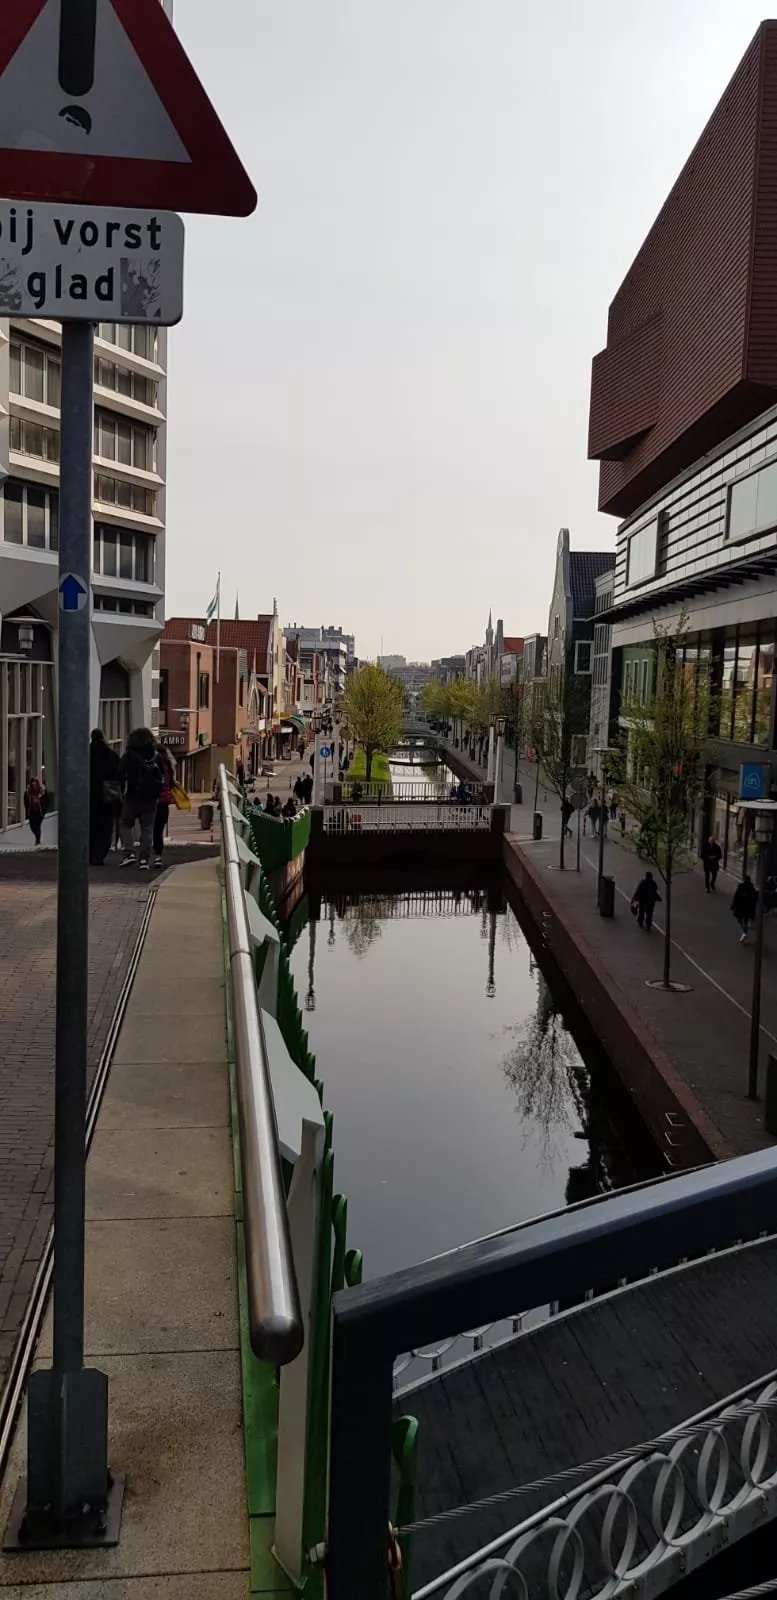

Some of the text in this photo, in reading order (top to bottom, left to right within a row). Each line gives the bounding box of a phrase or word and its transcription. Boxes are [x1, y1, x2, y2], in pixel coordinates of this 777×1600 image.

[0, 208, 162, 255] ij vorst
[27, 264, 114, 309] glad
